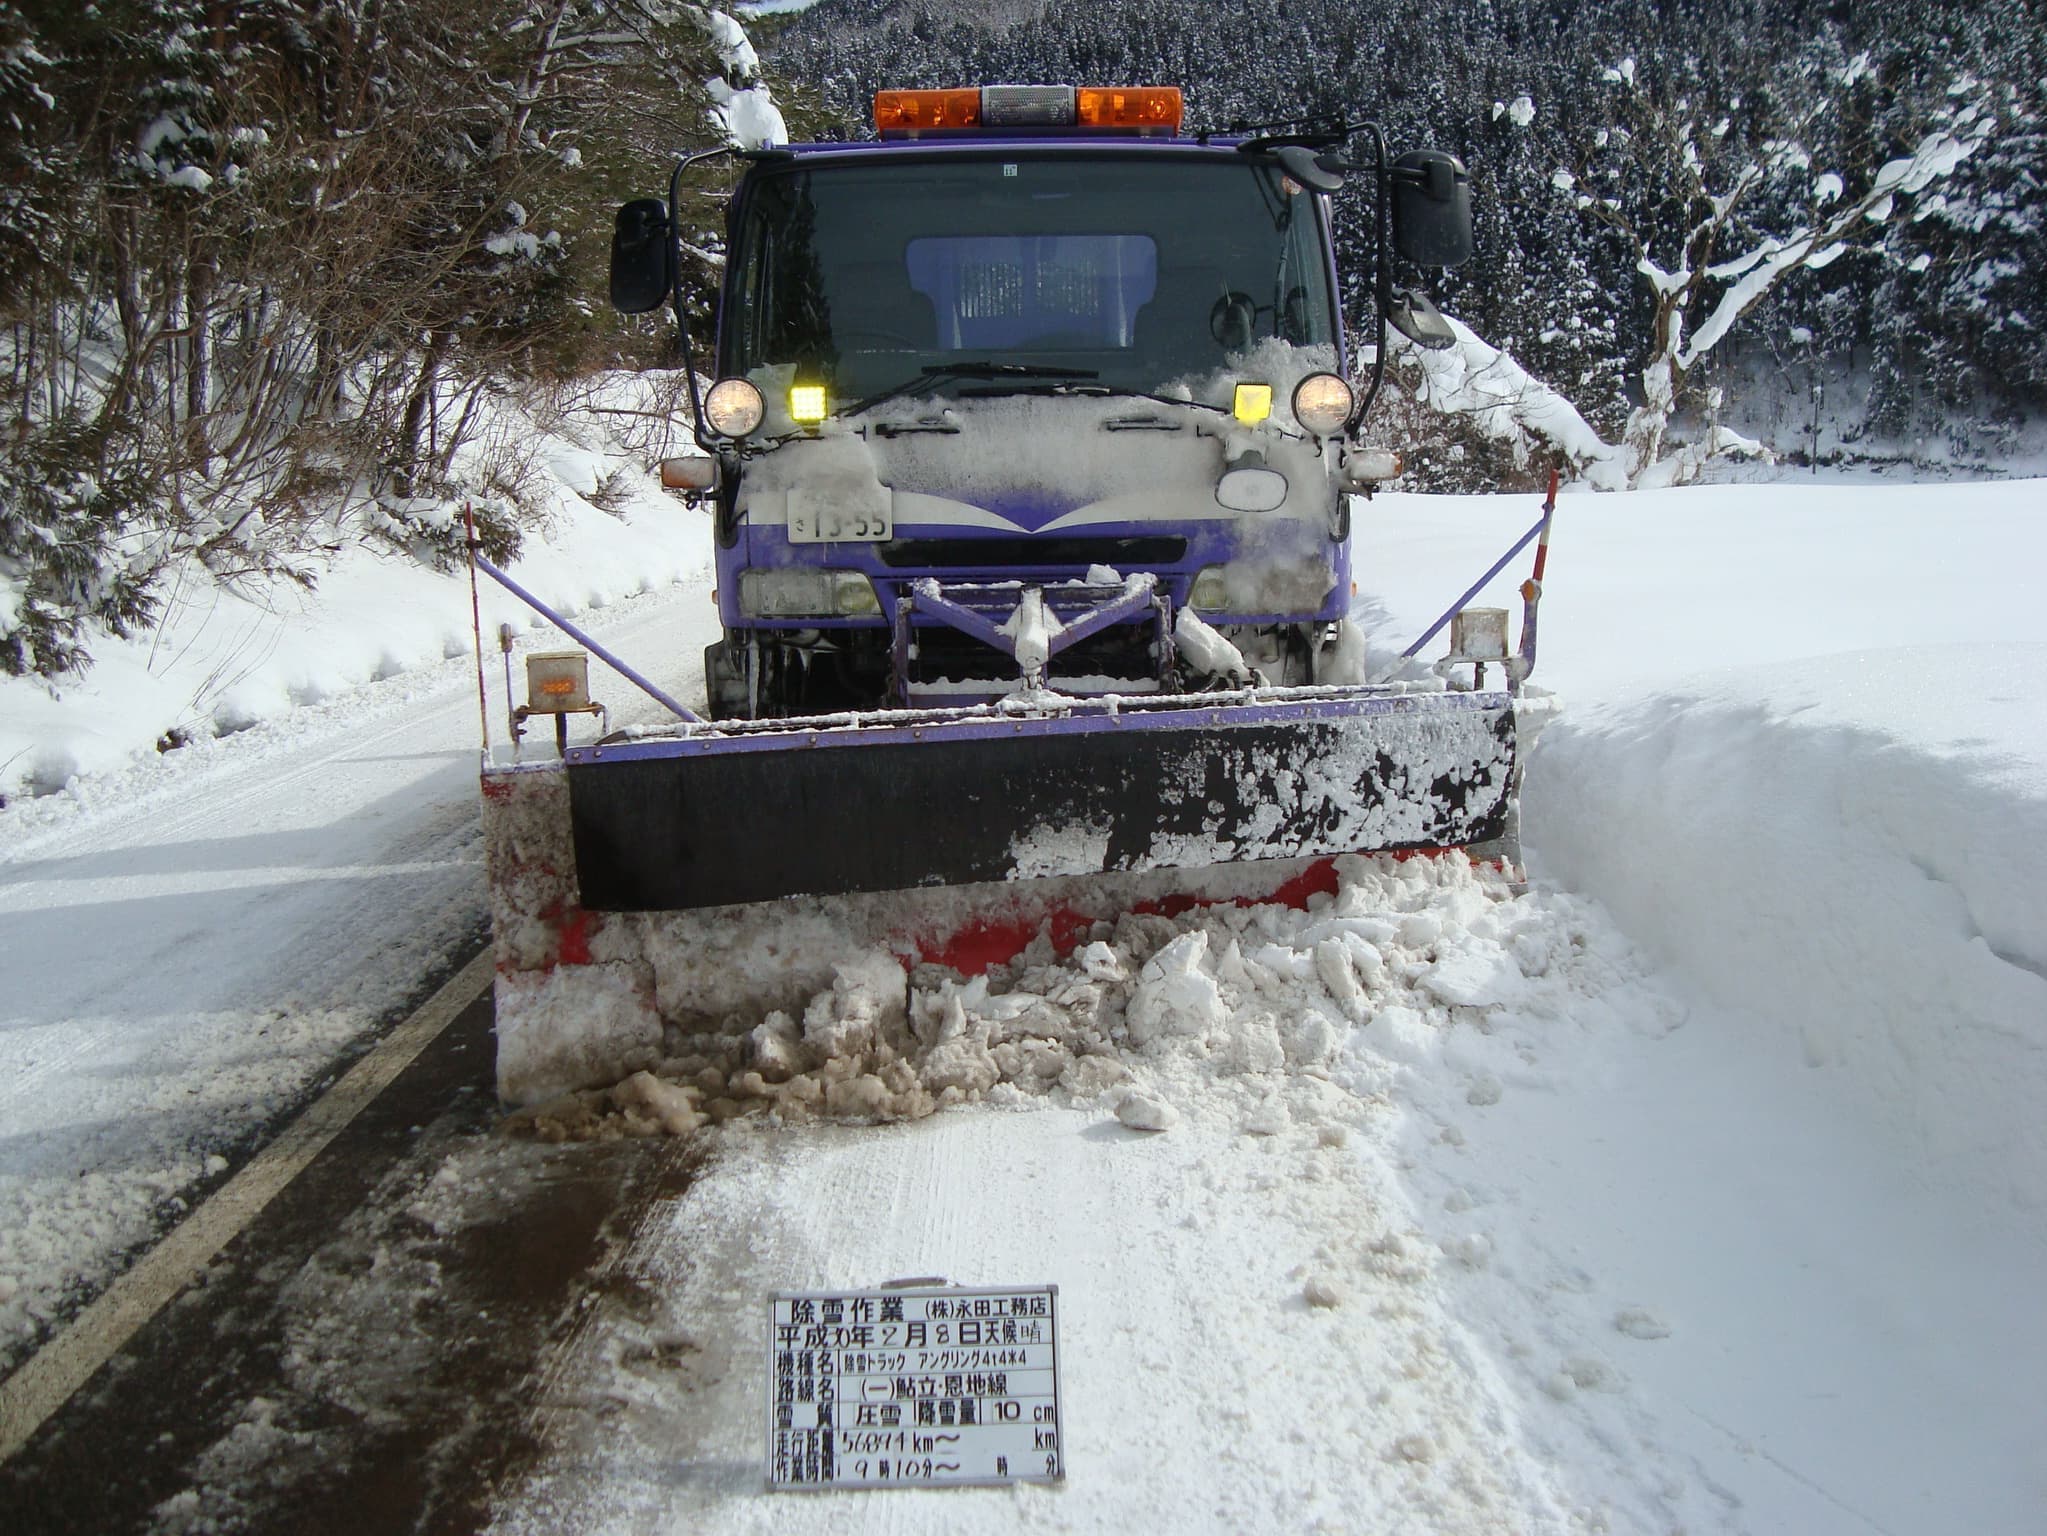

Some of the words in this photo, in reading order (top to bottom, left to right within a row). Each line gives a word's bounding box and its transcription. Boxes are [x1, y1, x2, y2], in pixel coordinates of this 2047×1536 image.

[791, 1297, 904, 1324] 除雪作業
[925, 1296, 1047, 1320] (株)永田工務店
[777, 1350, 834, 1376] 機種名
[777, 1376, 835, 1402] 路線名
[1034, 1426, 1056, 1449] km
